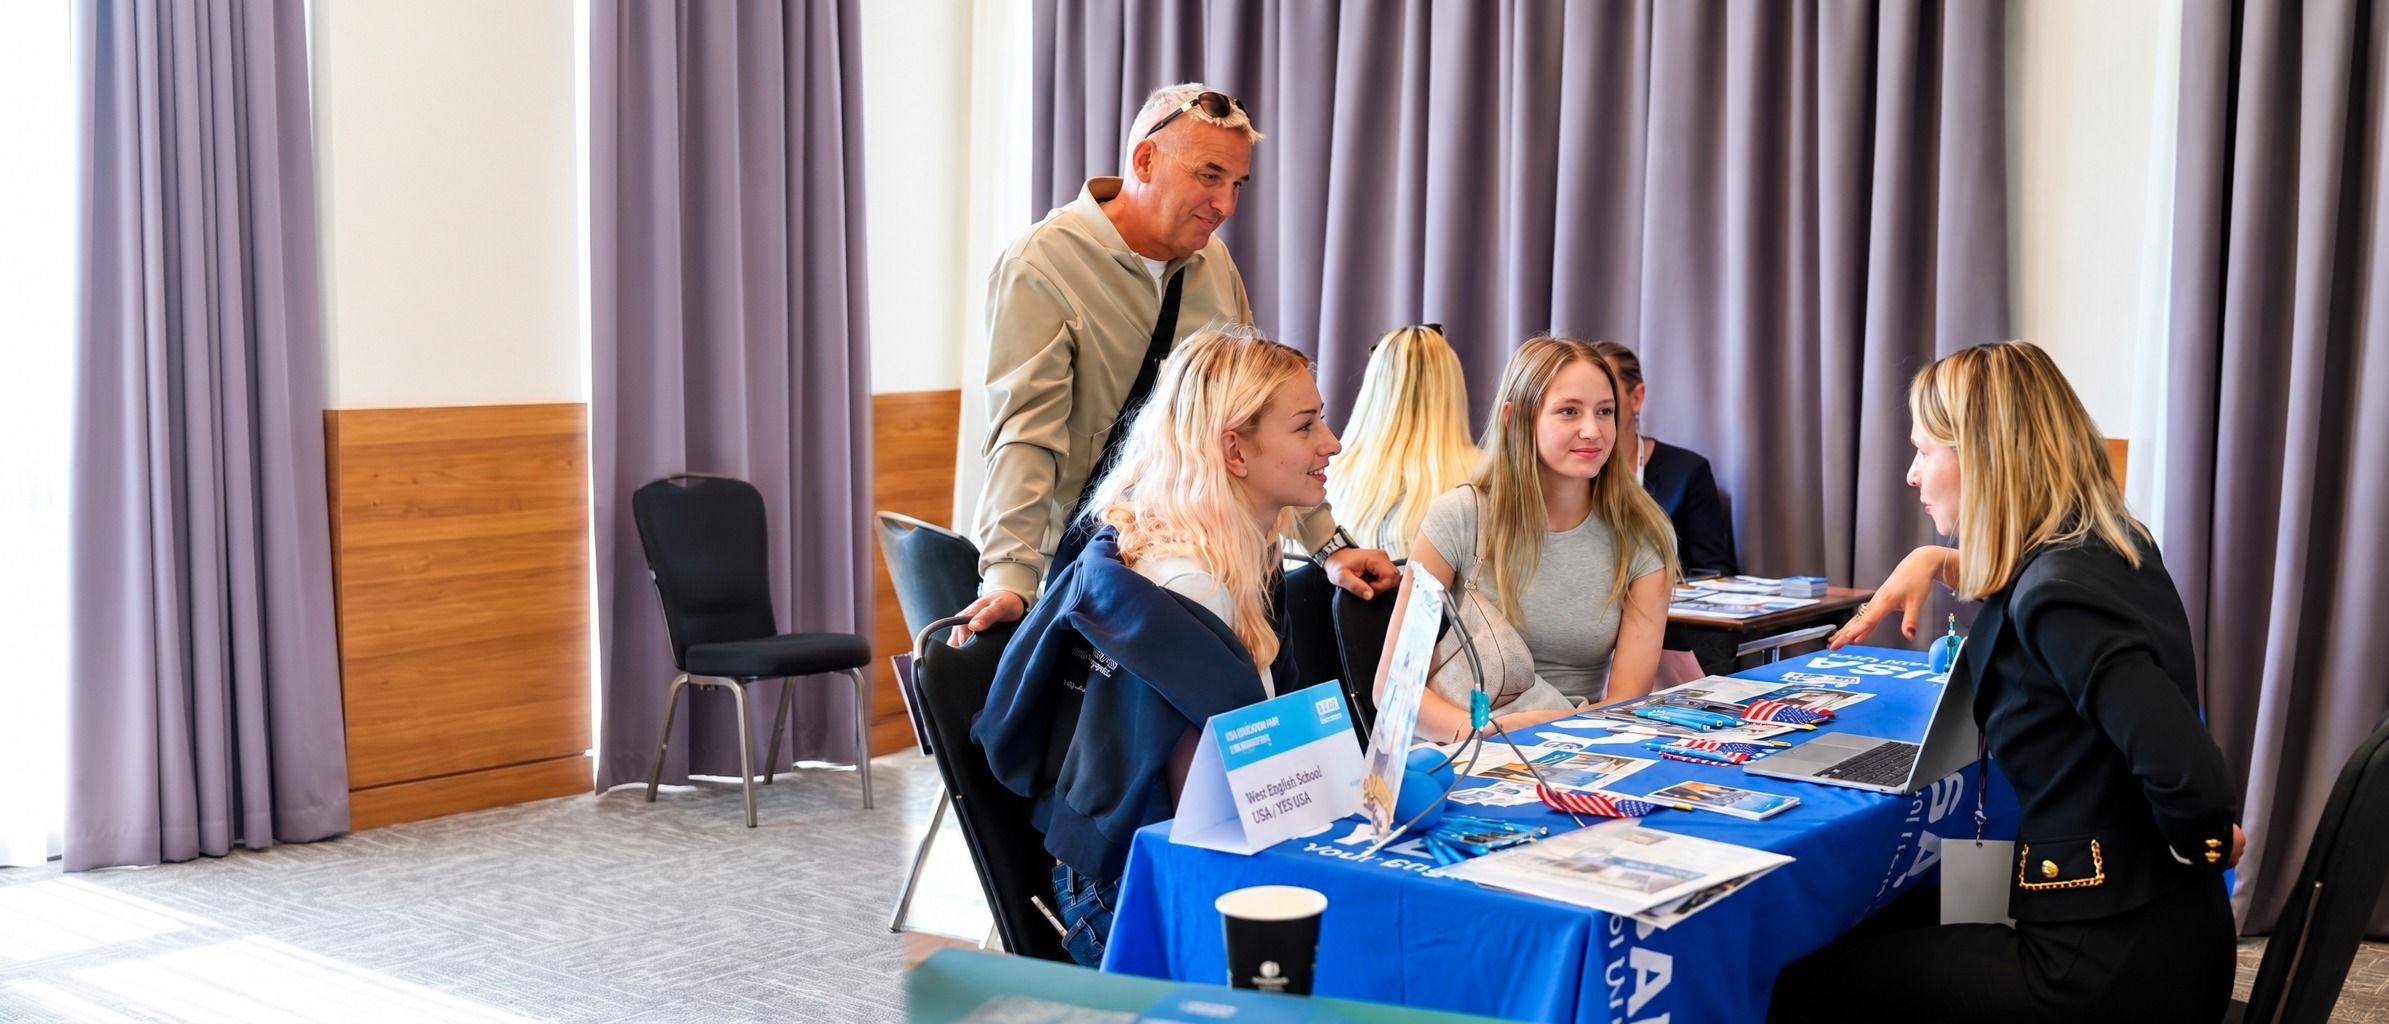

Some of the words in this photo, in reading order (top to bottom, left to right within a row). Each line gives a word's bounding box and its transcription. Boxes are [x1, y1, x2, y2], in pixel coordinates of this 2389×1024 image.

[1245, 788, 1267, 804] West
[1266, 776, 1297, 797] English
[1296, 765, 1323, 785] School
[1252, 807, 1273, 824] USA
[1276, 798, 1294, 814] YES
[1294, 792, 1312, 808] USA
[1907, 771, 1964, 877] SA
